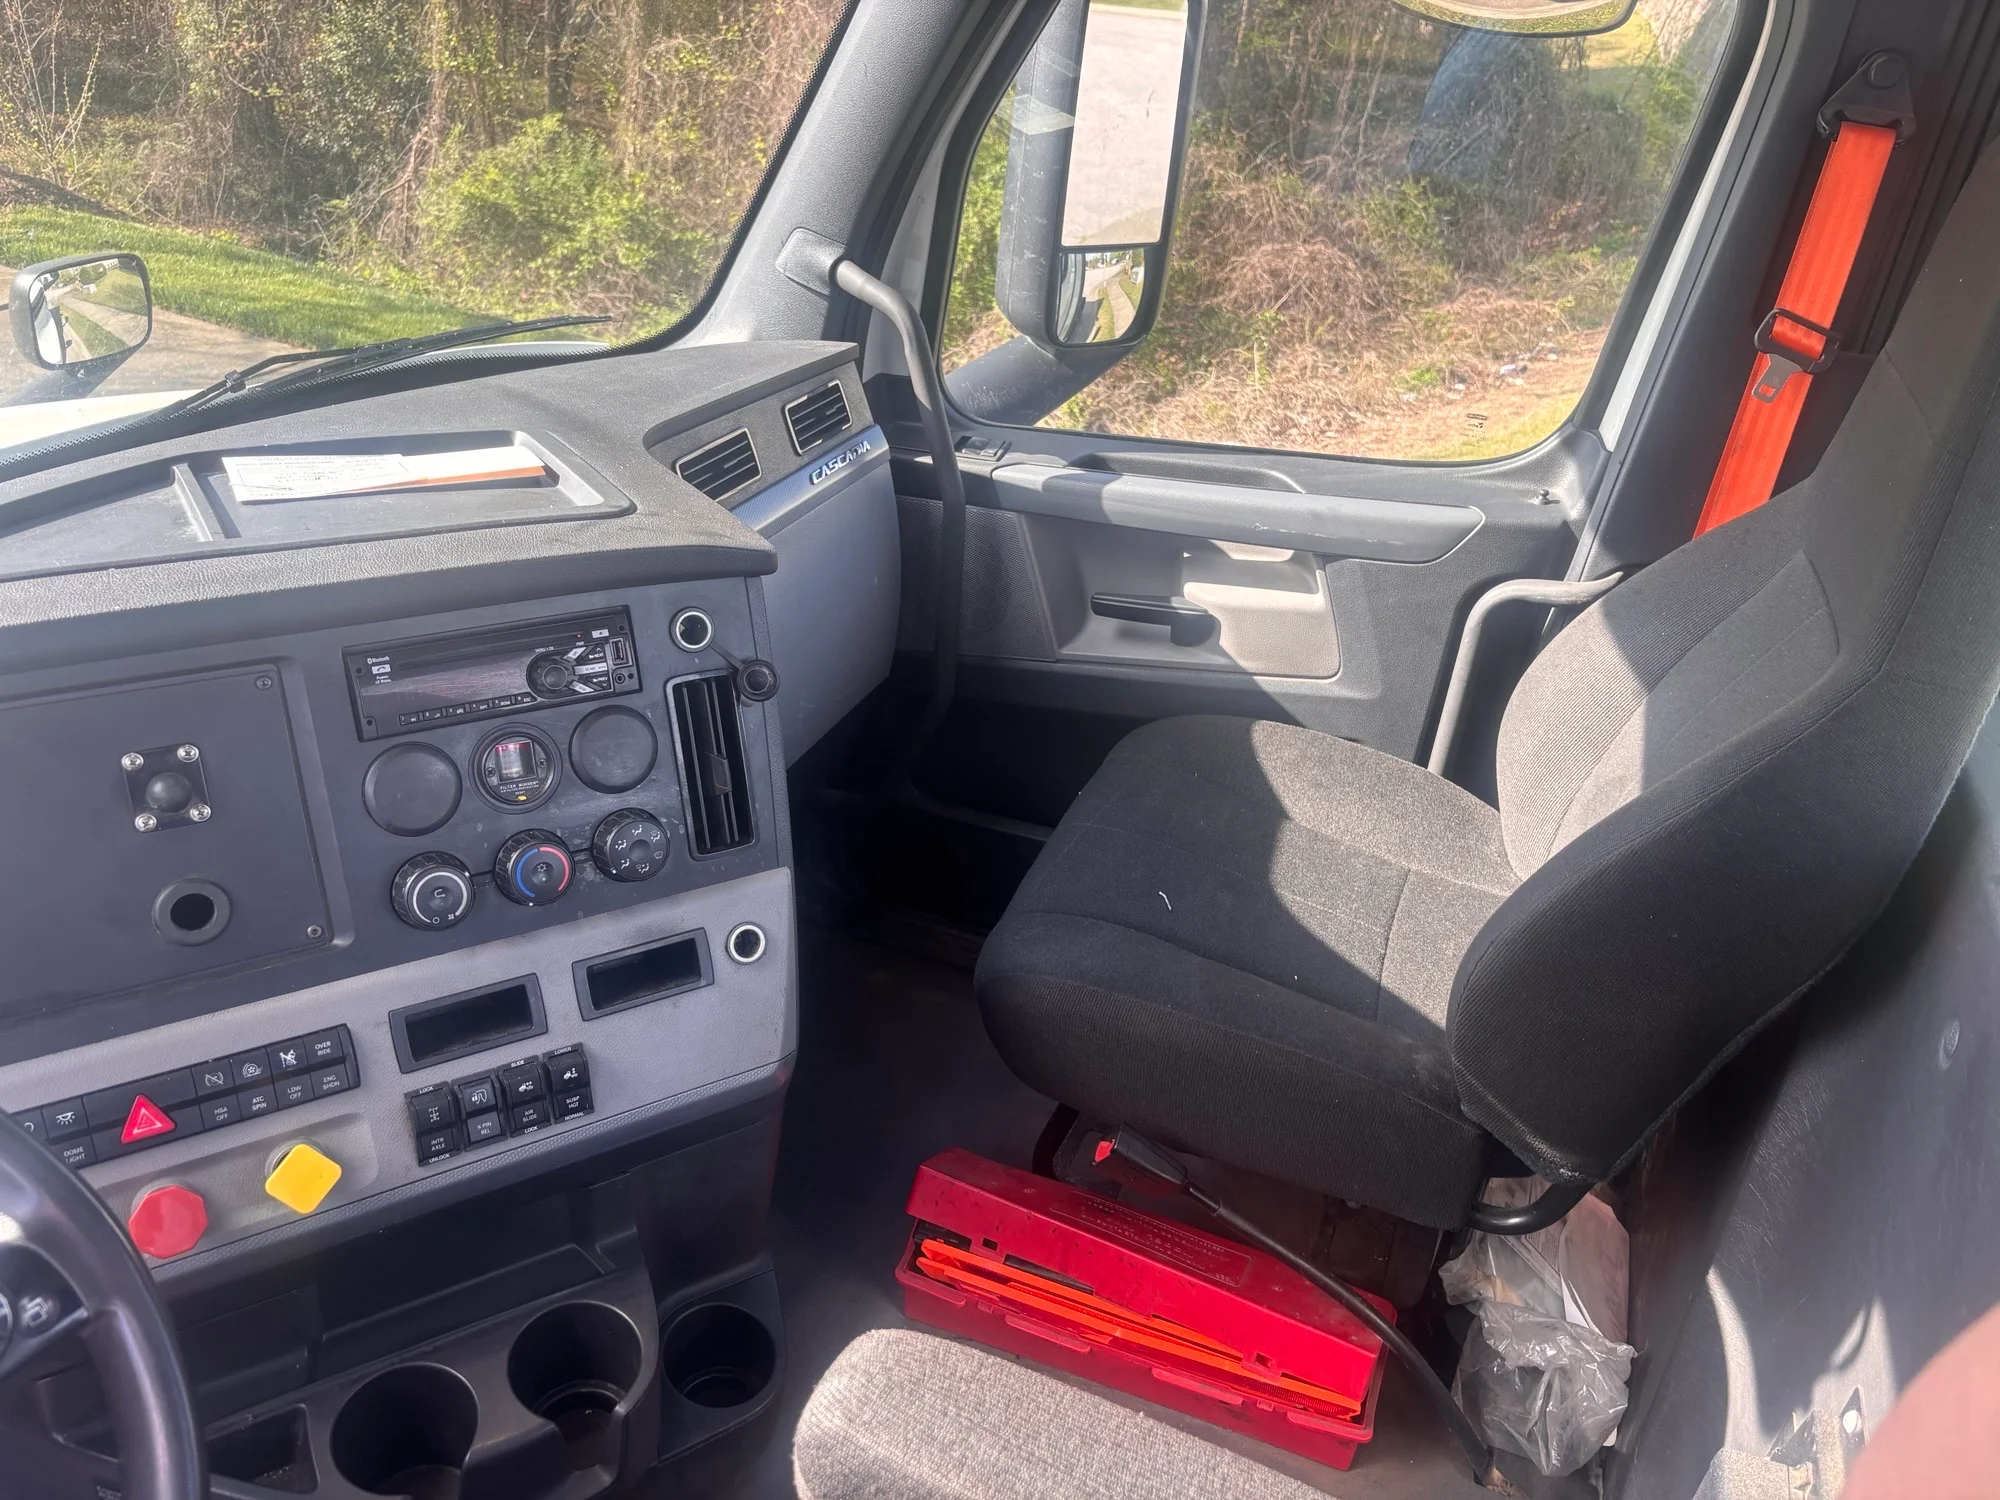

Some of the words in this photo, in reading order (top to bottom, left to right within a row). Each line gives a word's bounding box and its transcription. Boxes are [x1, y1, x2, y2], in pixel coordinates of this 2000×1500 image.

[811, 440, 871, 485] CASCADIA
[314, 1040, 332, 1051] OVER
[317, 1048, 332, 1056] RIDE
[554, 1046, 572, 1056] LOWER
[510, 1059, 525, 1068] SLIDE
[322, 1075, 337, 1084] ENG
[322, 1079, 340, 1089] SHDN
[287, 1084, 302, 1094] LDW
[419, 1085, 434, 1094] LOCK
[289, 1090, 302, 1100] OFF
[566, 1095, 580, 1104] SUSP
[252, 1095, 265, 1105] ATC
[252, 1101, 267, 1111] SPIN
[214, 1107, 229, 1116] HSA
[524, 1109, 534, 1117] AIR
[564, 1111, 585, 1121] NORMAL
[216, 1112, 229, 1121] OFF
[523, 1113, 538, 1122] SLIDE
[480, 1127, 491, 1135] REL
[524, 1125, 539, 1134] LOCK
[431, 1137, 444, 1146] INTR
[431, 1142, 446, 1151] AXLE
[63, 1146, 85, 1157] DOME
[65, 1153, 86, 1164] LIGHT
[428, 1152, 451, 1164] UNLOCK
